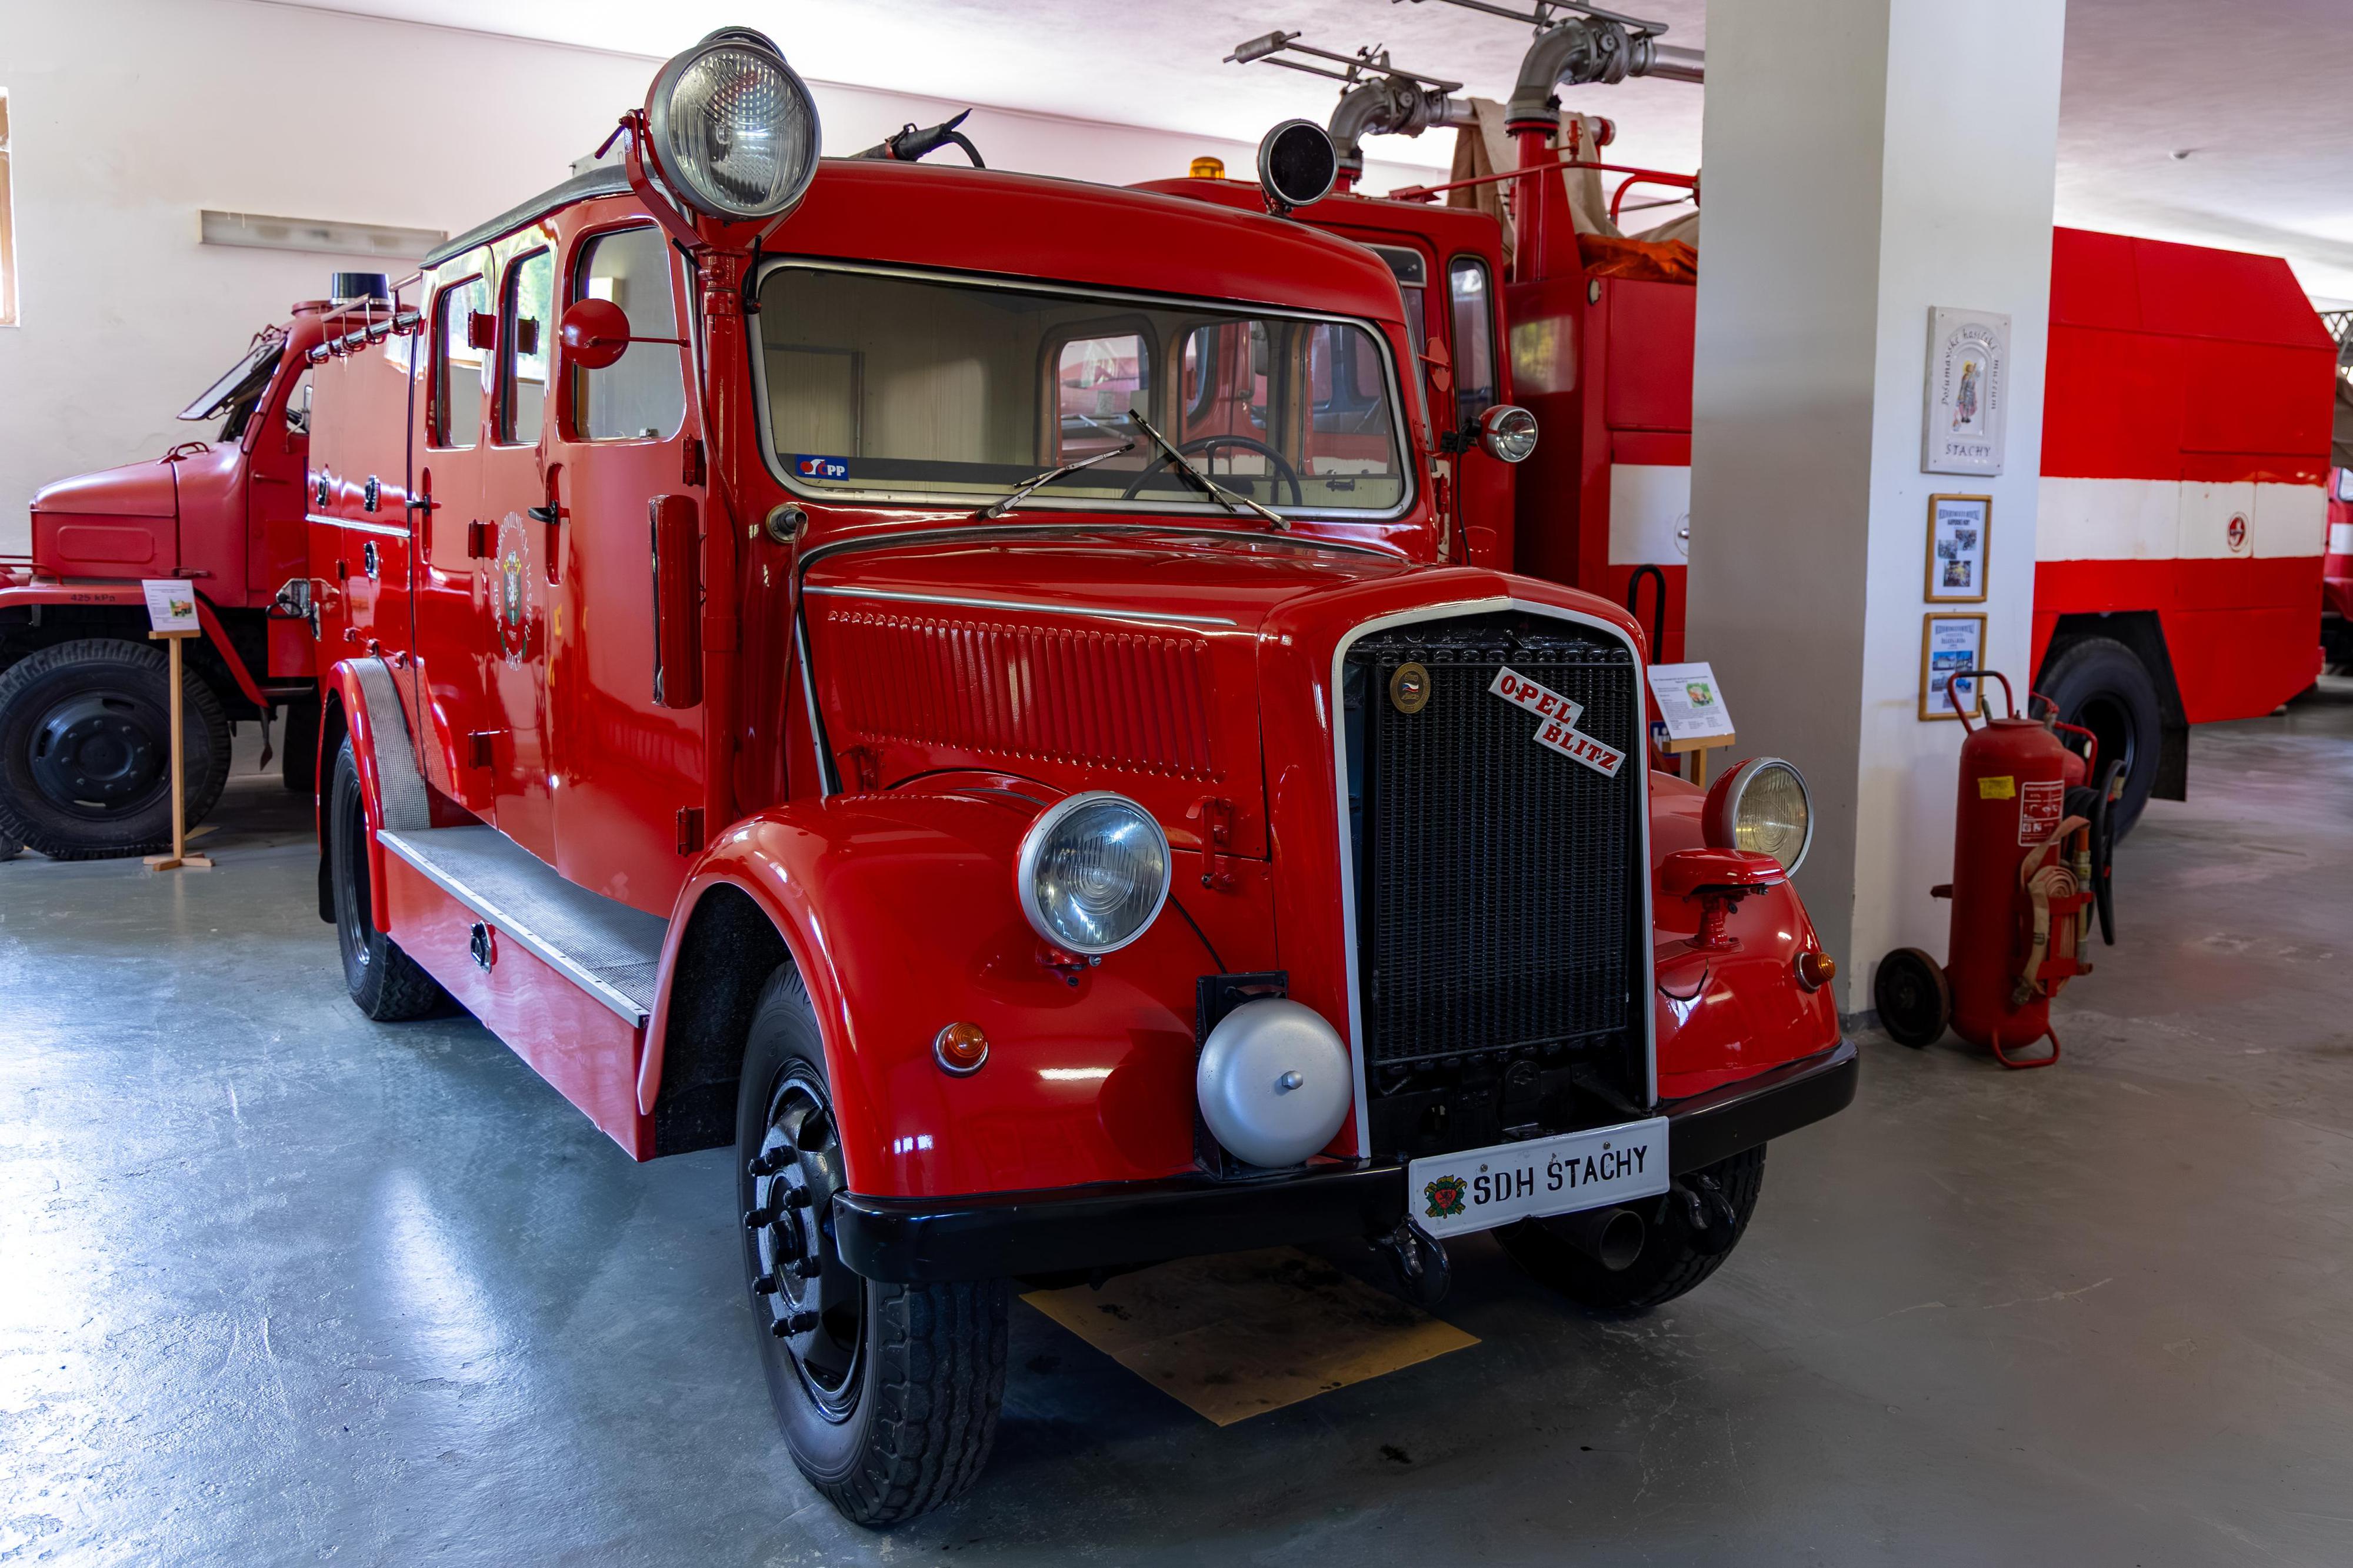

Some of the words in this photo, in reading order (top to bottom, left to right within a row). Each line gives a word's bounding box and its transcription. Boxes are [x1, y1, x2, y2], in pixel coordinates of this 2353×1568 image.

[1945, 443, 1991, 457] STACHY
[818, 460, 845, 476] ČPP
[71, 593, 91, 602] 425
[506, 647, 522, 671] STACHY
[1500, 675, 1572, 725] OPEL
[1542, 723, 1619, 772] BLITZ
[1474, 1167, 1534, 1205] SDH
[1547, 1145, 1648, 1192] STACHY
